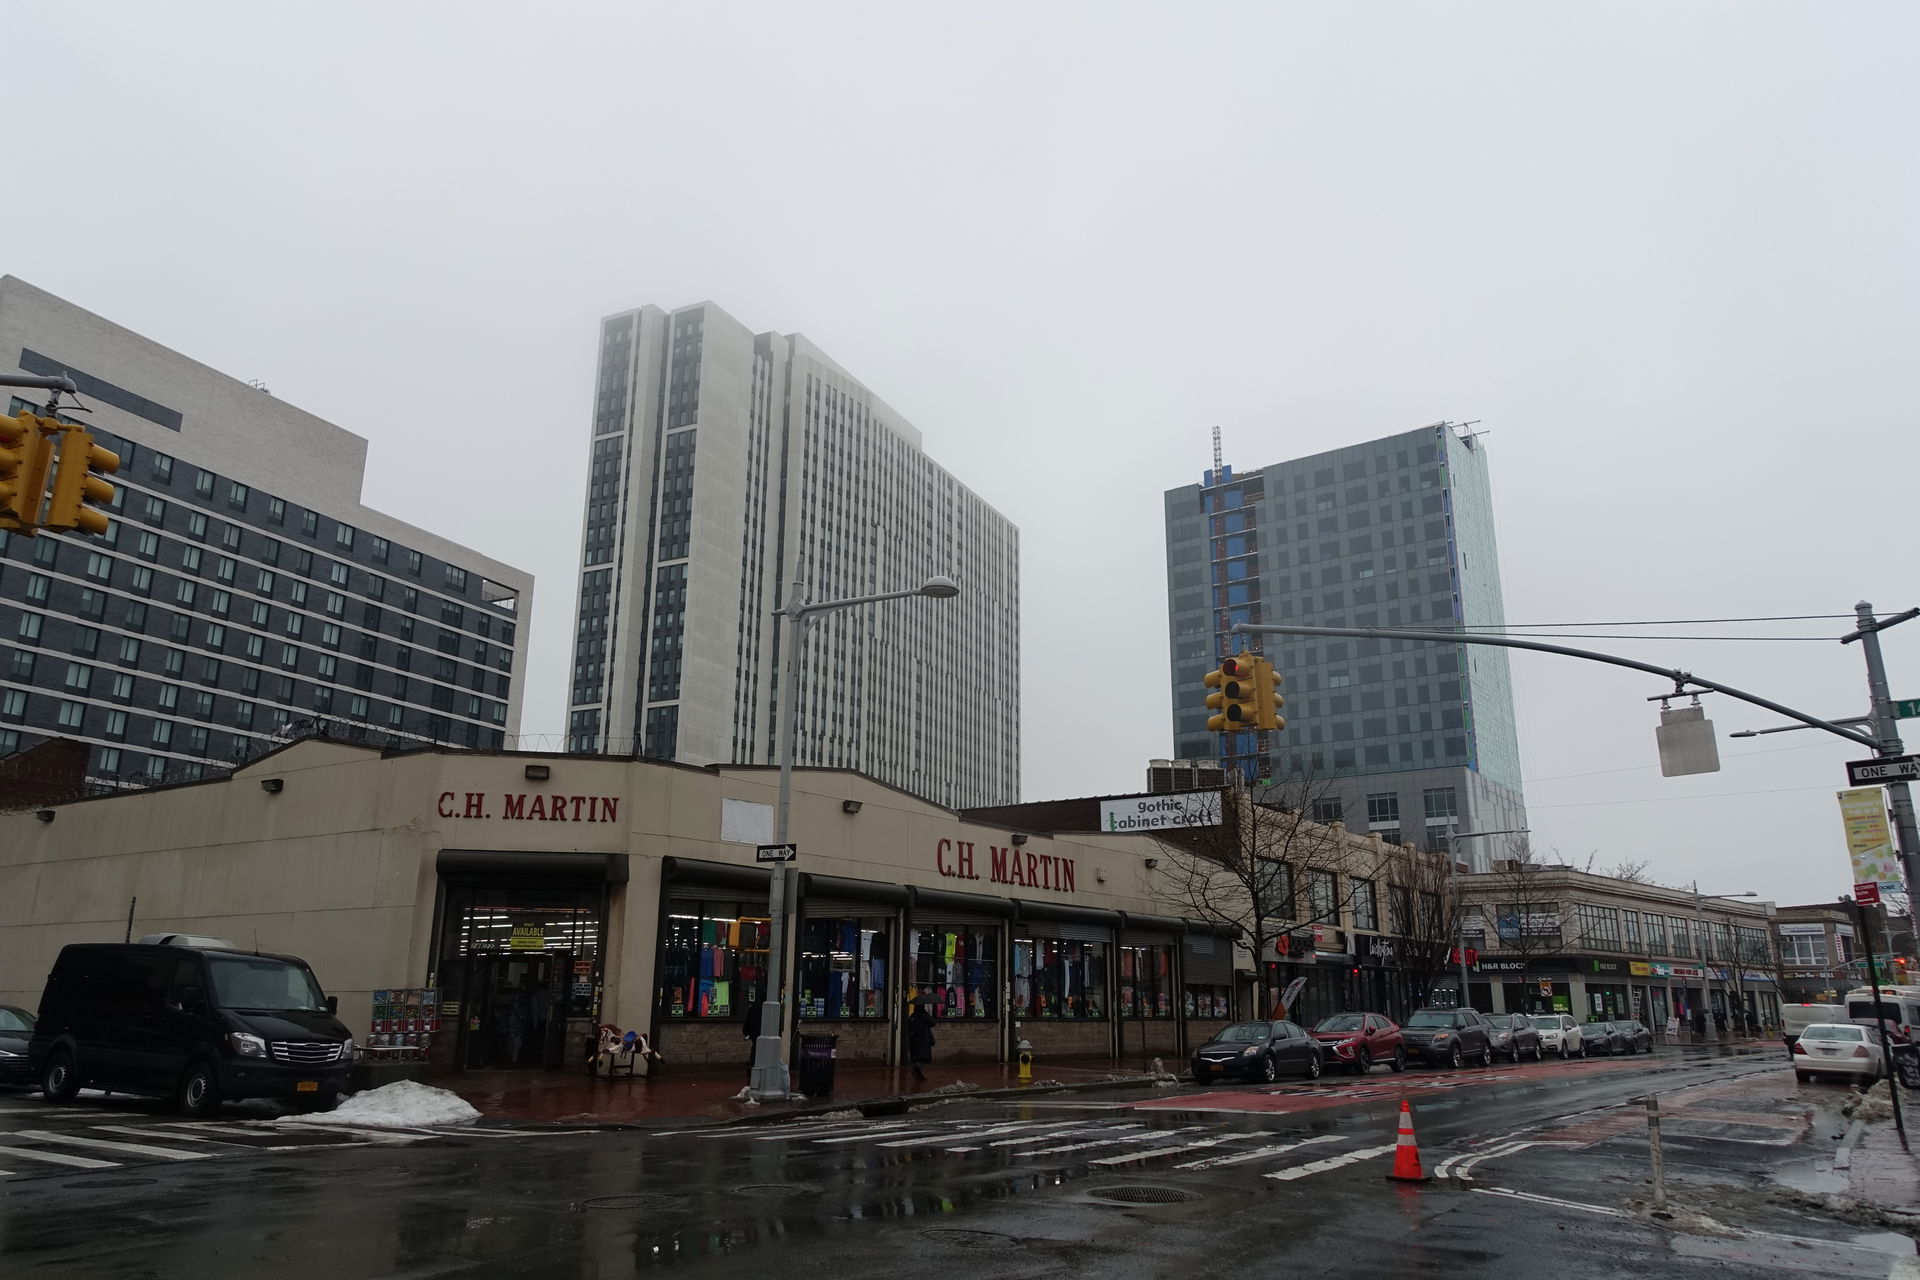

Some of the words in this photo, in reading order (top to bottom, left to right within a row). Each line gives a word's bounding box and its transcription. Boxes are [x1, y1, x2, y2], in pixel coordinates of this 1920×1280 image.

[1907, 701, 1920, 715] 1
[1861, 766, 1888, 778] ONE
[438, 792, 490, 818] C.H.
[503, 794, 619, 823] MARTIN
[1138, 799, 1182, 814] gothic
[762, 849, 774, 858] ONE
[779, 849, 791, 857] WAY
[937, 838, 979, 880] C.H.
[990, 846, 1074, 893] MARTIN
[513, 927, 544, 936] AVAILABLE
[1452, 947, 1479, 966] BEUTY
